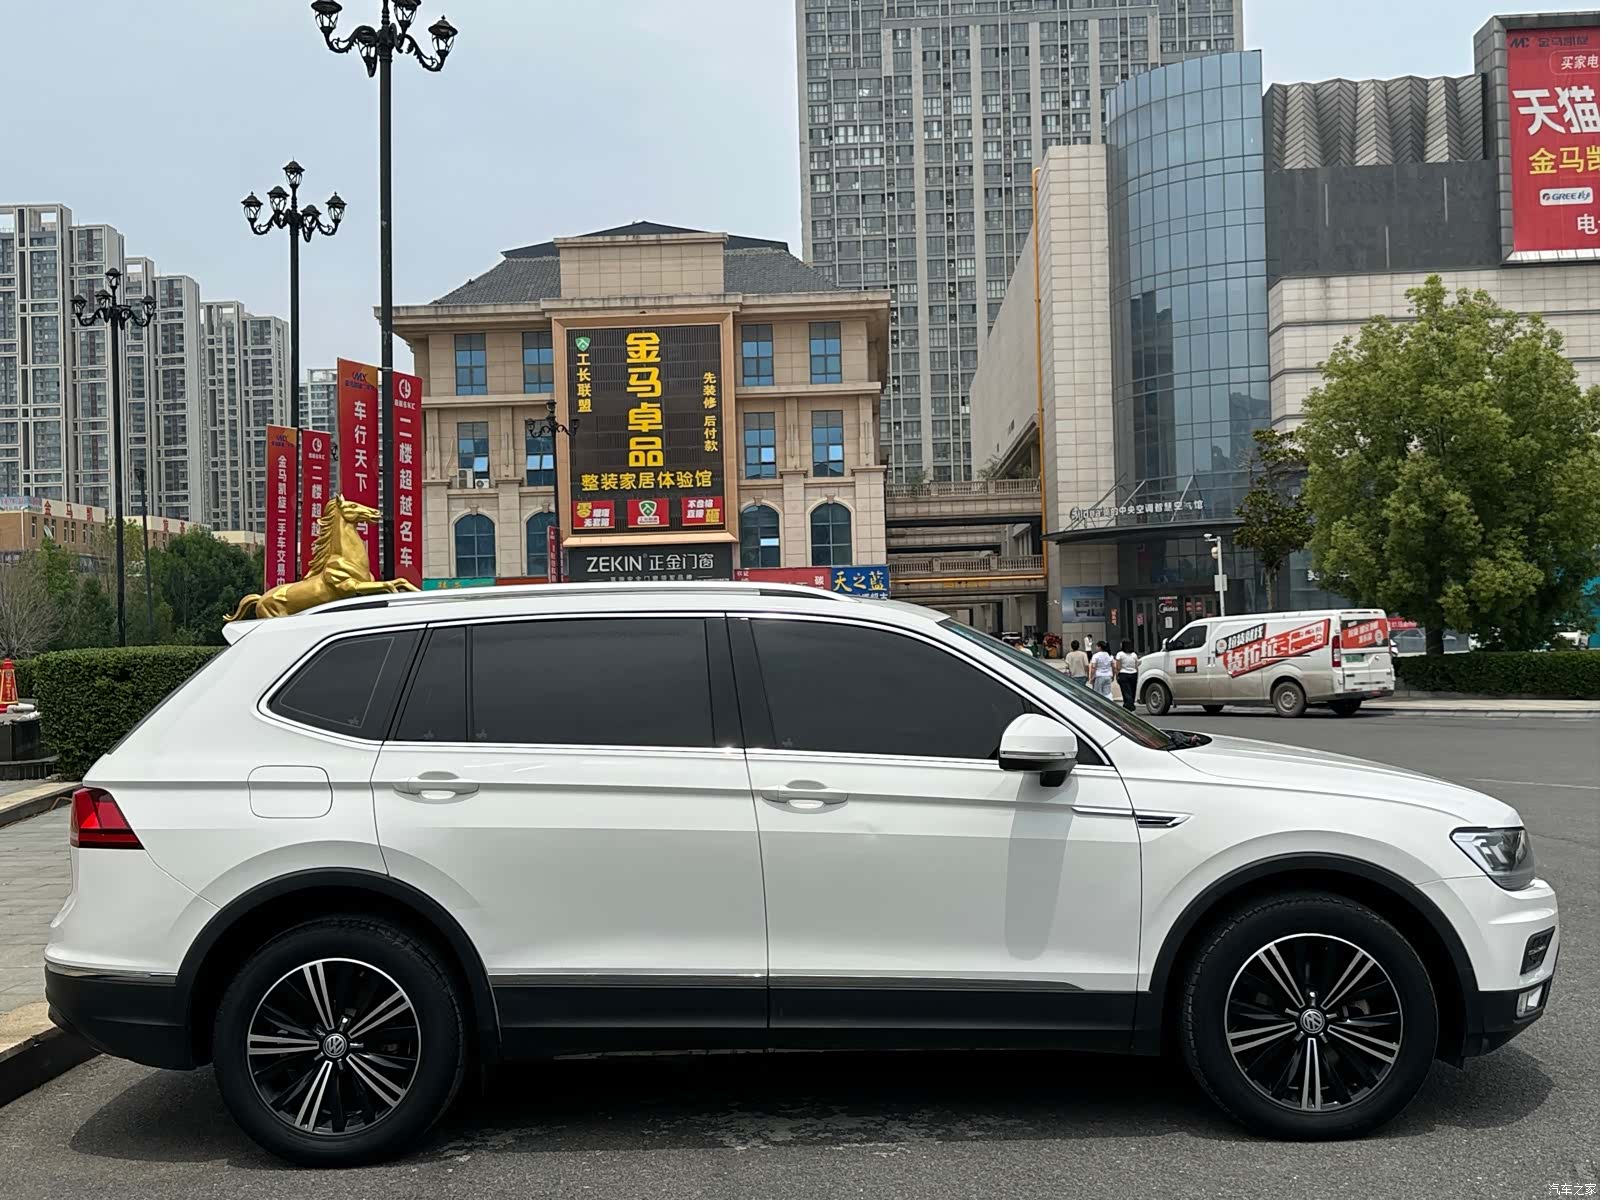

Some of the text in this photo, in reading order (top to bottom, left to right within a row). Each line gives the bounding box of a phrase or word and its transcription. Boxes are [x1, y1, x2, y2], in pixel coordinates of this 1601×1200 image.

[1561, 54, 1600, 70] 买家电
[1512, 85, 1600, 136] 天猫
[576, 353, 593, 413] 工长联盟
[626, 332, 664, 467] 金马卓品
[354, 400, 369, 492] 车行天下
[399, 416, 413, 568] 二楼超越名车
[581, 470, 713, 492] 整装家居体验馆
[648, 553, 714, 571] 正金门窗
